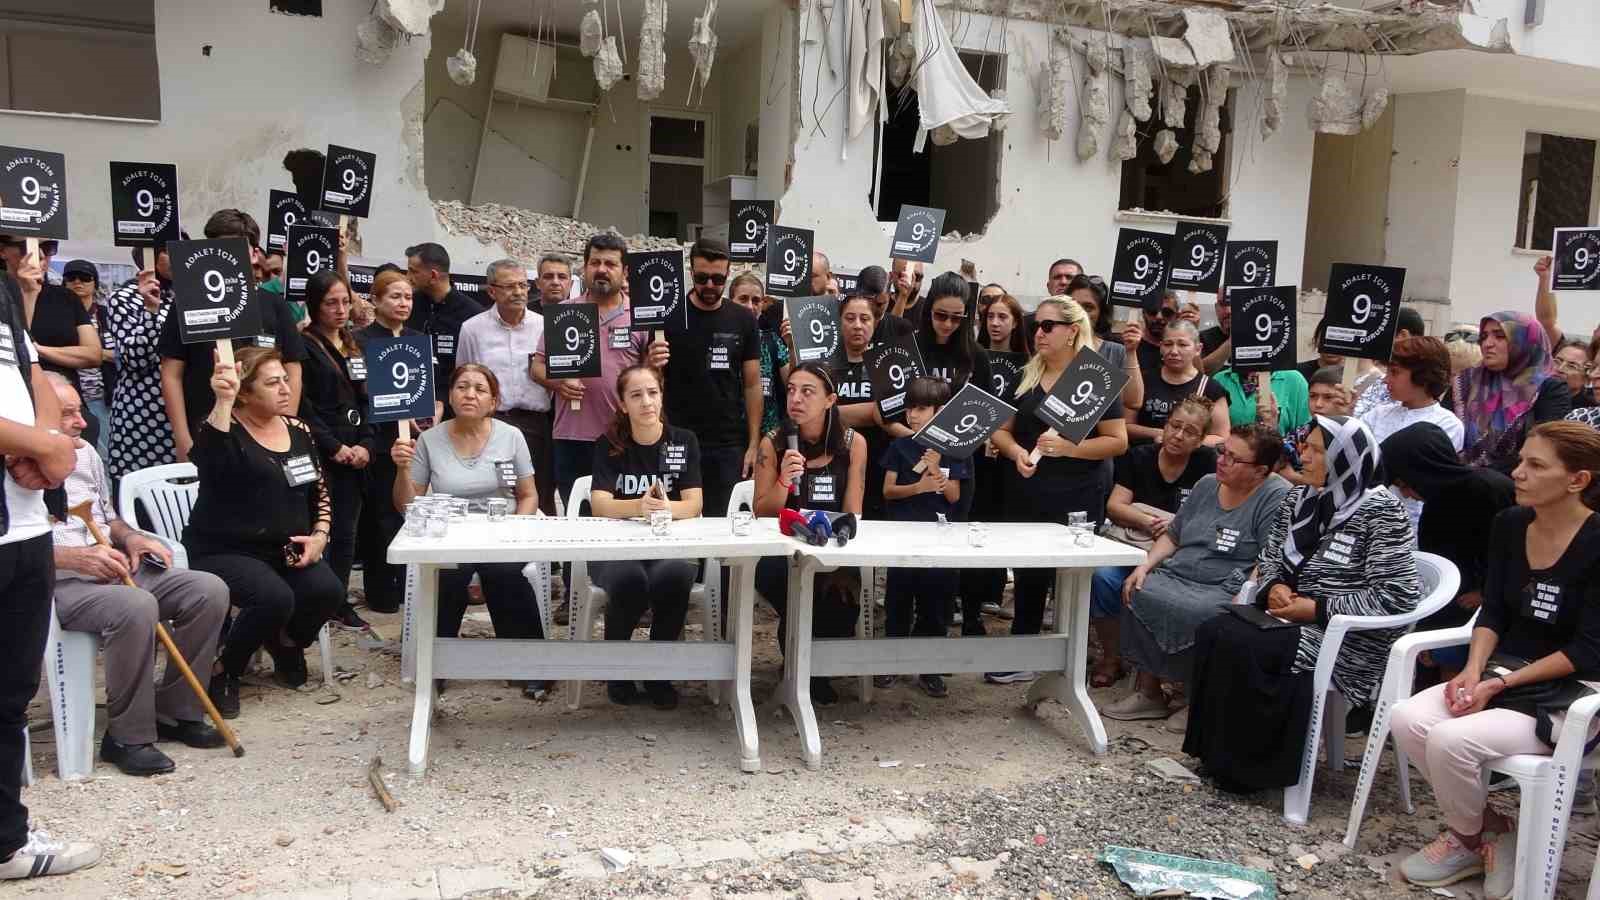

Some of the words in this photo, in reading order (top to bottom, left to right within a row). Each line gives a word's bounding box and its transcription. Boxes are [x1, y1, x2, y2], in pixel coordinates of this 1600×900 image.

[6, 157, 35, 172] ADALET
[122, 170, 147, 187] ADALET
[342, 169, 356, 191] 9
[21, 176, 40, 206] 9
[136, 189, 154, 217] 9
[36, 183, 60, 224] DURUŞMAYA
[150, 193, 172, 234] DURUŞMAYA
[745, 219, 757, 240] 9
[911, 222, 925, 241] 9
[1126, 236, 1149, 251] ADALET
[1190, 244, 1205, 267] 9
[184, 247, 215, 270] ADALET
[217, 248, 239, 267] İÇİN
[306, 250, 320, 274] 9
[638, 257, 659, 274] ADALET
[784, 248, 796, 272] 9
[1133, 254, 1149, 280] 9
[1573, 247, 1589, 270] 9
[1243, 260, 1257, 283] 9
[1341, 273, 1371, 290] ADALET
[1373, 273, 1391, 294] İÇİN
[203, 270, 225, 303] 9
[224, 272, 249, 322] DURUŞMAYA
[649, 275, 664, 302] 9
[660, 278, 680, 317] DURUŞMAYA
[1242, 294, 1267, 312] ADALET
[1351, 293, 1371, 324] 9
[553, 310, 575, 325] ADALET
[1255, 313, 1272, 341] 9
[1359, 300, 1392, 343] DURUŞMAYA
[565, 326, 579, 351] 9
[810, 319, 824, 343] 9
[1267, 315, 1291, 359] DURUŞMAYA
[377, 343, 402, 361] ADALET
[405, 343, 421, 359] İÇİN
[392, 361, 409, 389] 9
[888, 364, 905, 389] 9
[1079, 363, 1104, 374] ADALET
[405, 362, 427, 406] DURUŞMAYA
[837, 382, 871, 398] ALE
[1071, 380, 1093, 406] 9
[1066, 395, 1106, 423] DURUŞMAYA
[954, 414, 977, 434] 9
[616, 473, 679, 494] ADAE
[1554, 765, 1566, 812] SEYHAN
